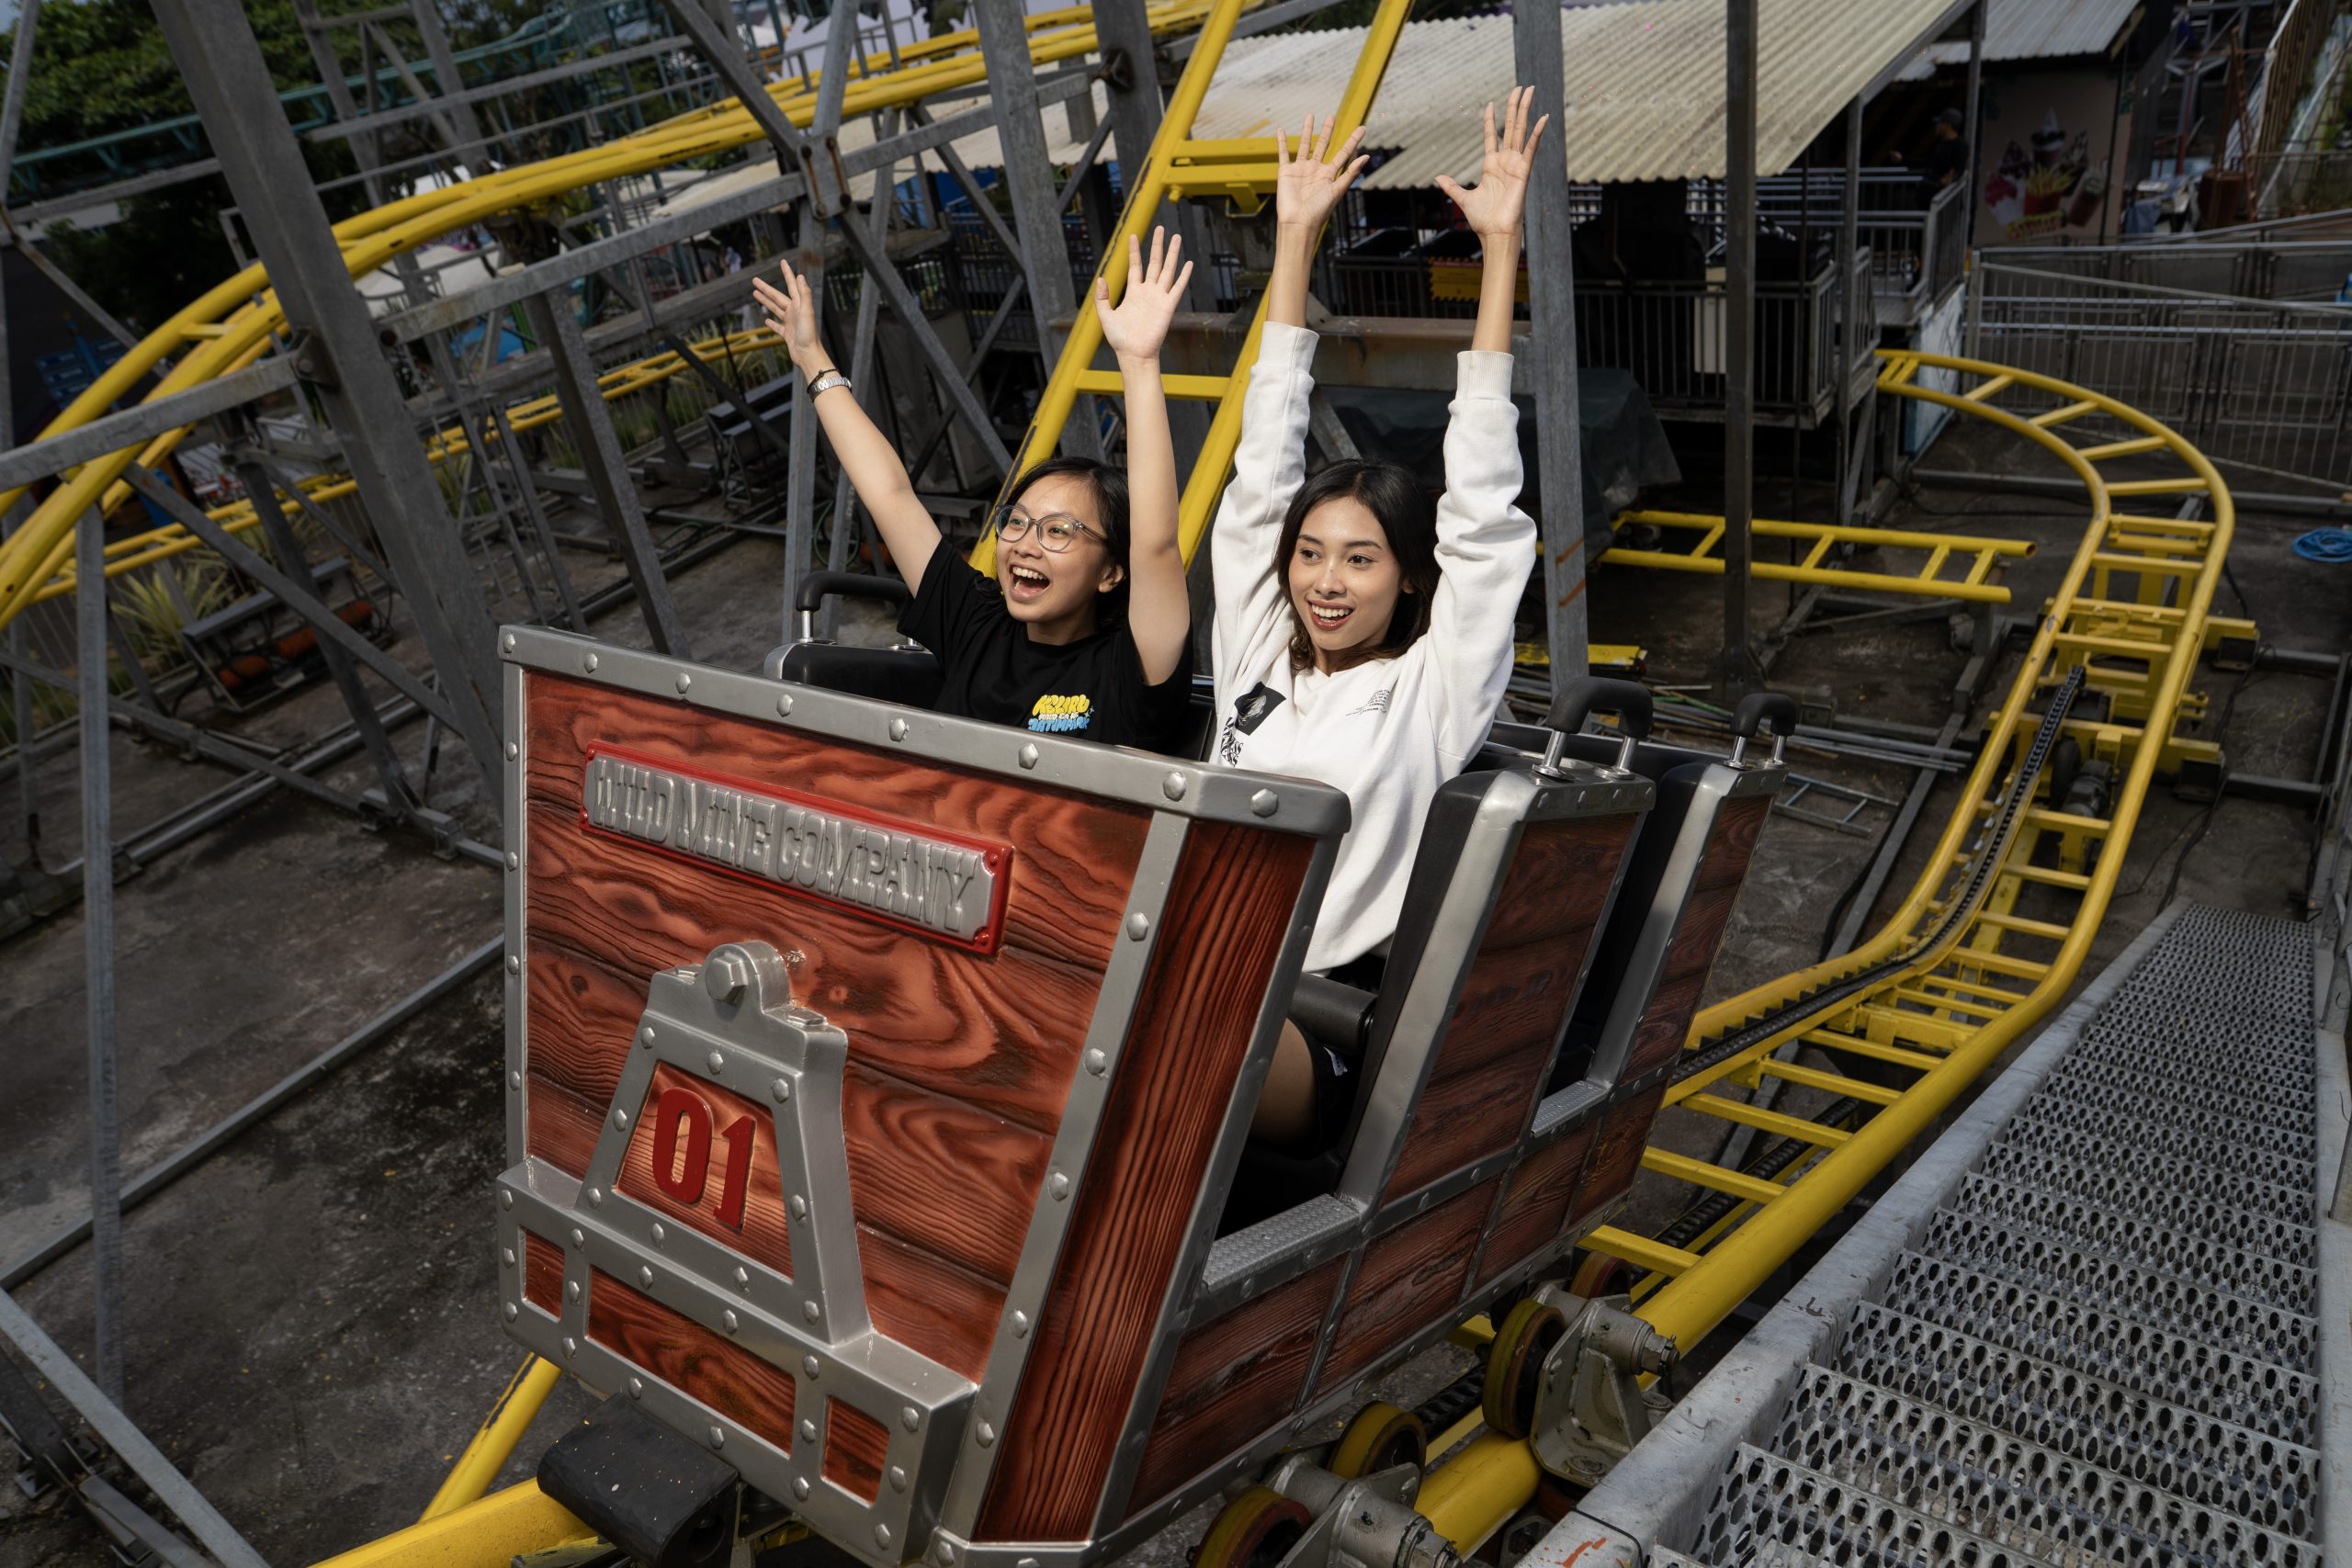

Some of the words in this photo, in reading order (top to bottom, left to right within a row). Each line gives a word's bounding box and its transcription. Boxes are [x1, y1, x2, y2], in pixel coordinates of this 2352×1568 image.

[593, 759, 675, 844] WILD
[676, 783, 775, 875] MINE
[777, 808, 978, 931] COMPANY
[652, 1087, 757, 1232] 01
